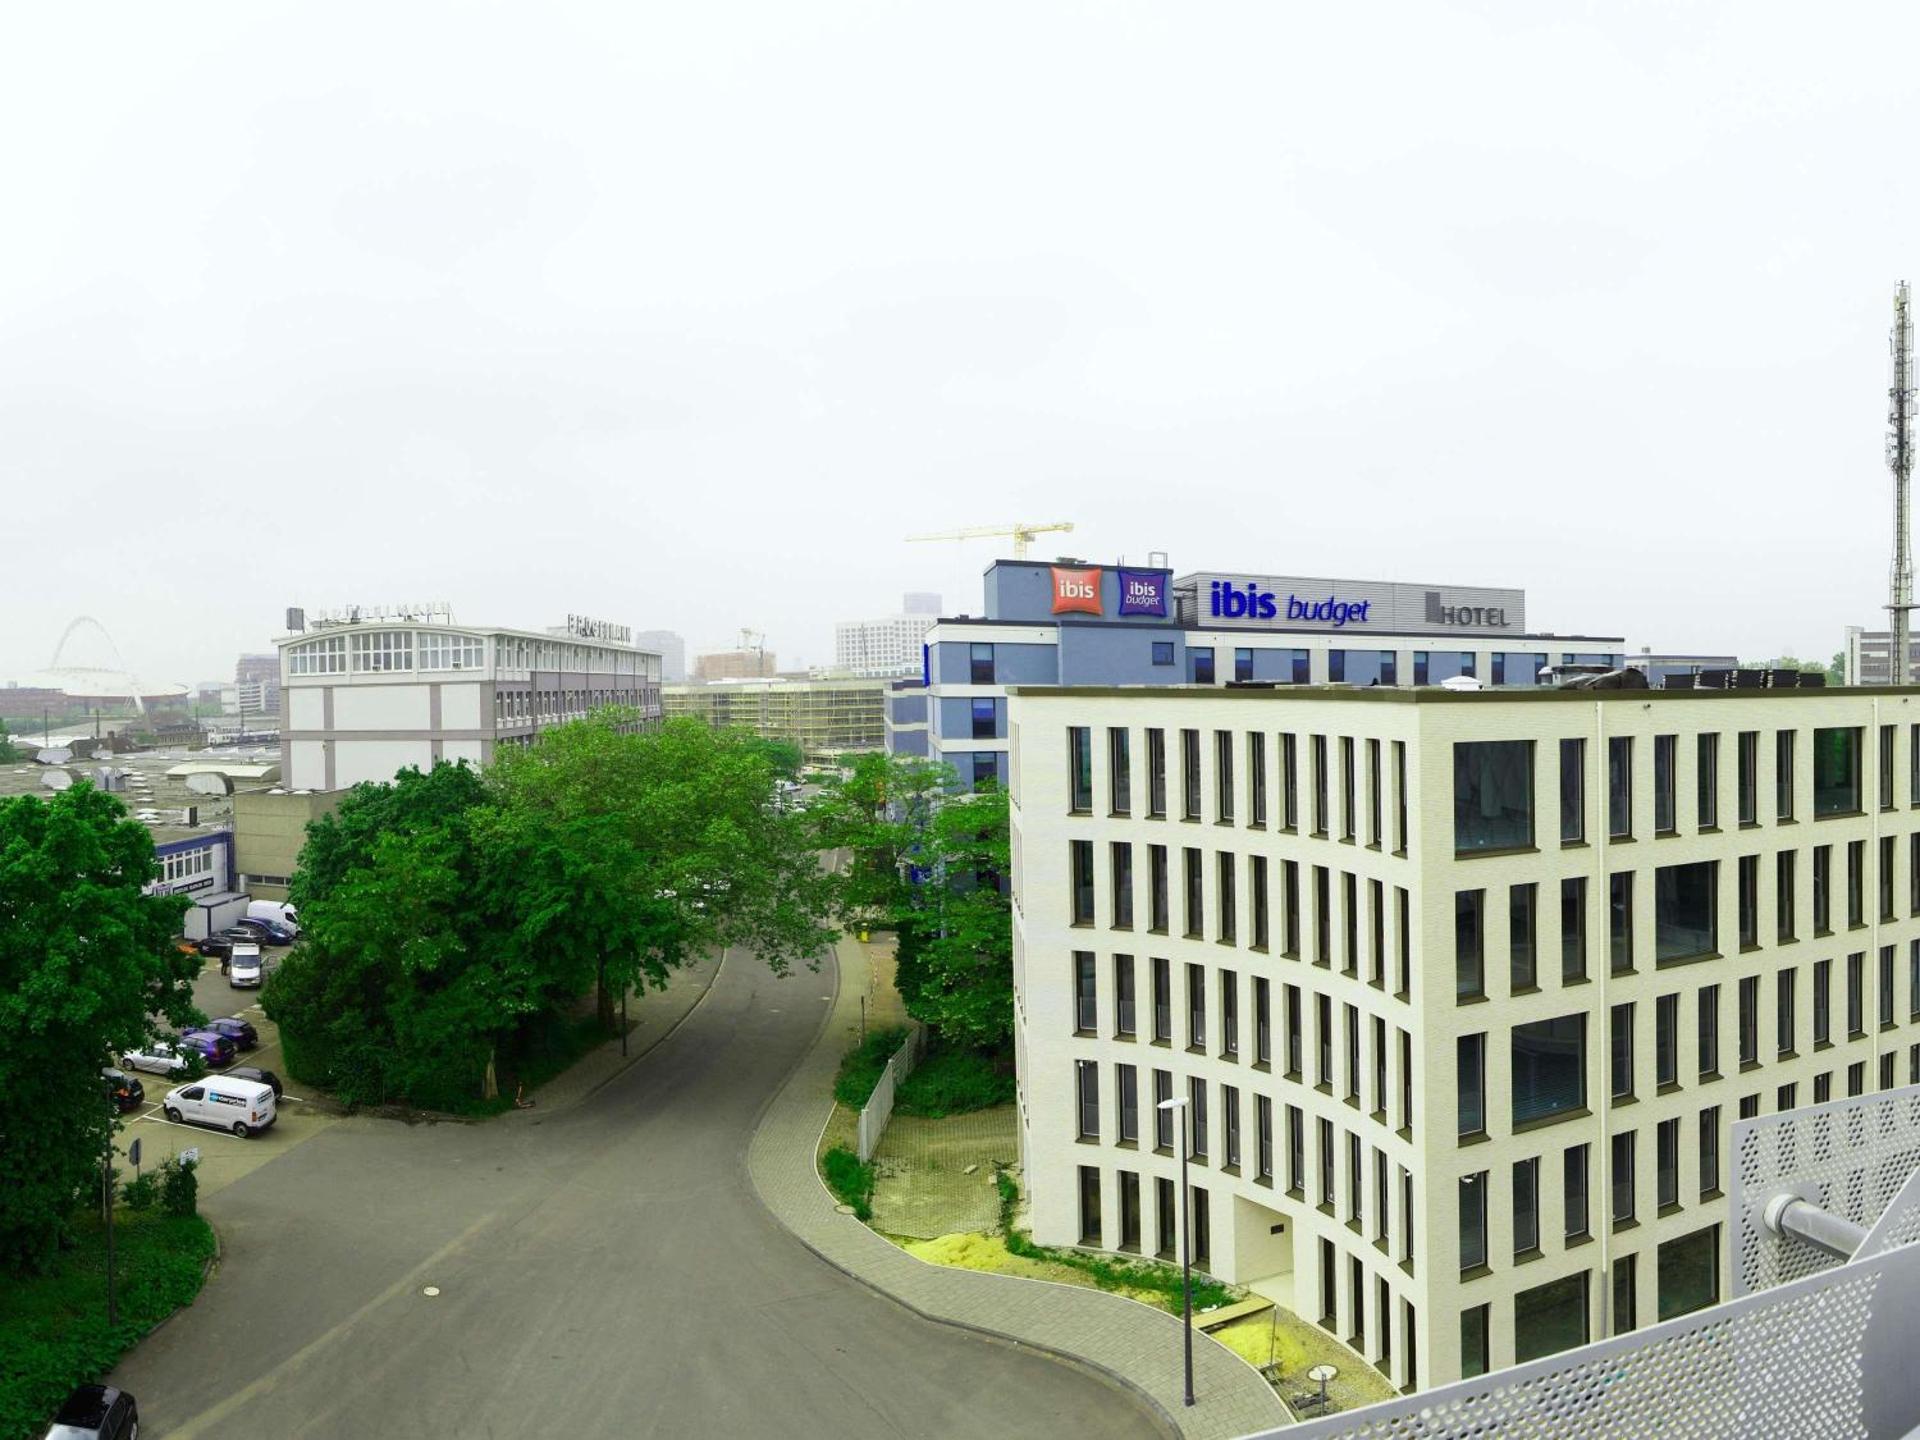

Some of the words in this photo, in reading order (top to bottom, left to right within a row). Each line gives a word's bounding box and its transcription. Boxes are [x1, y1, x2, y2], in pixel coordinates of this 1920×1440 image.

[1060, 580, 1095, 599] ibis
[1129, 582, 1156, 597] ibis
[1125, 594, 1160, 607] budget
[1211, 580, 1277, 619] ibis
[1287, 595, 1371, 627] budget
[1441, 605, 1511, 626] HOTEL
